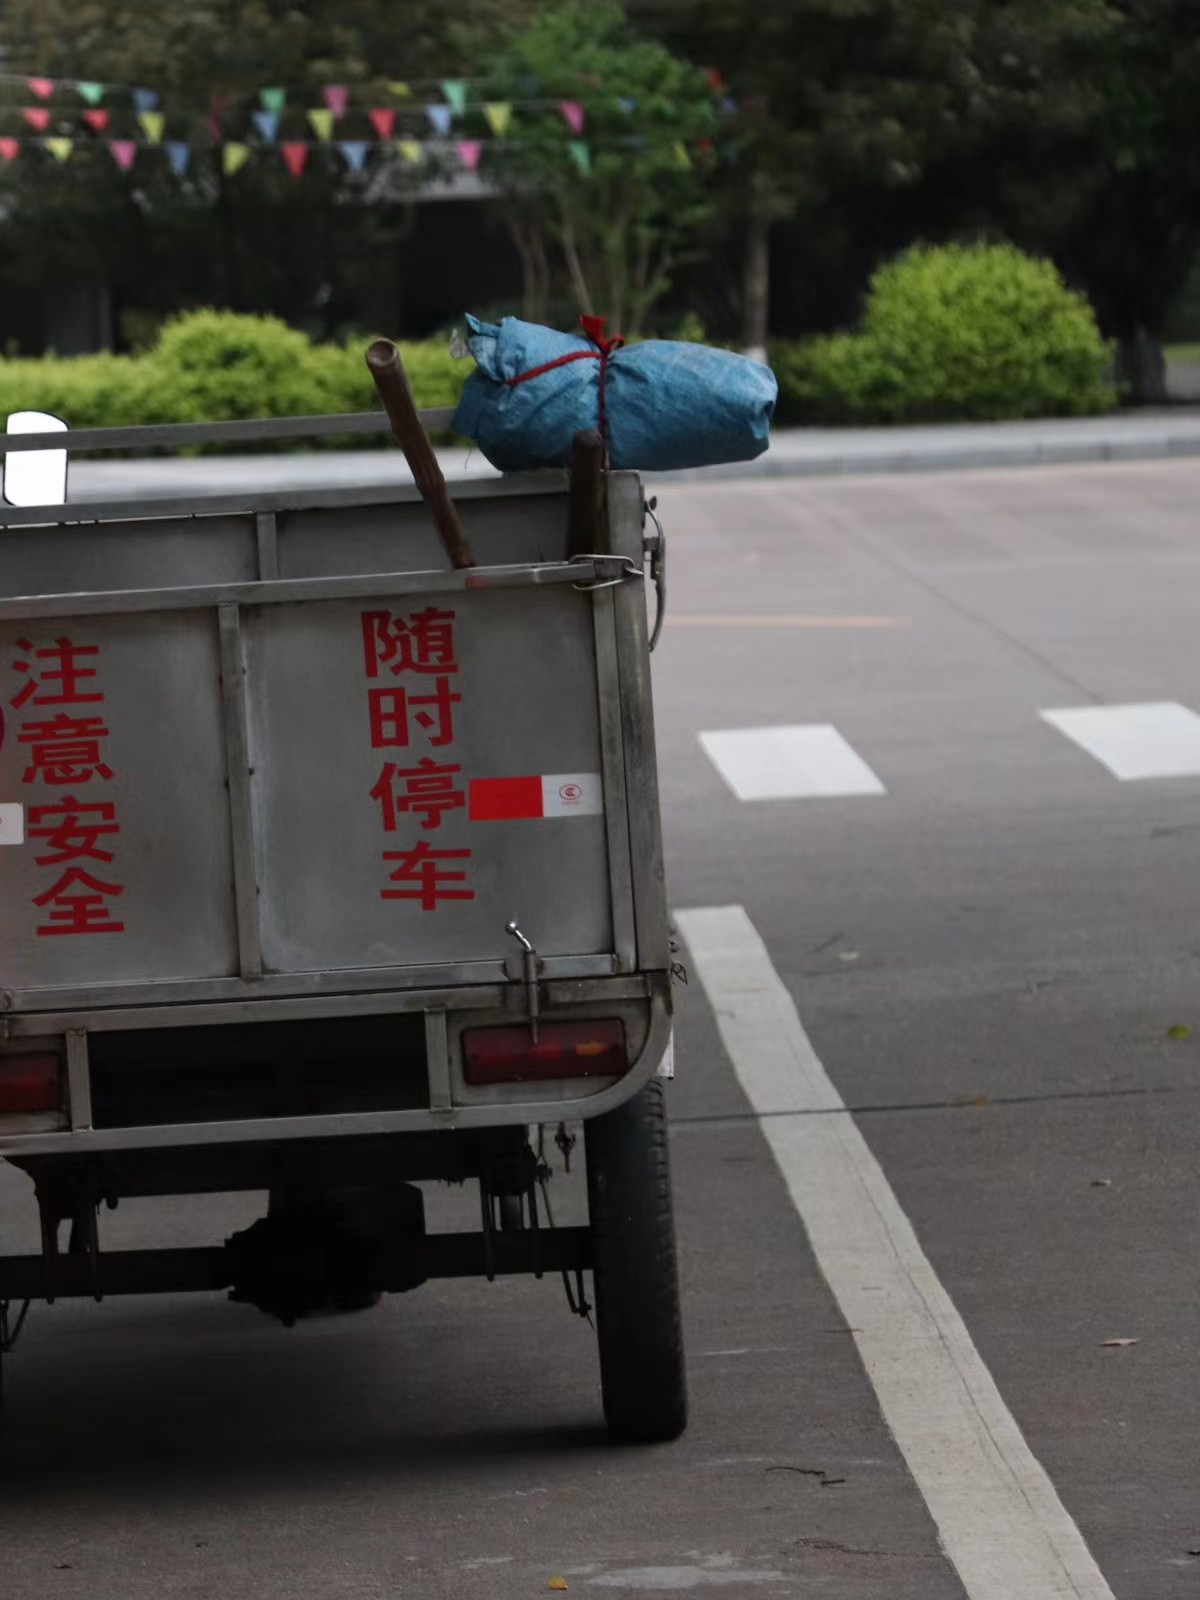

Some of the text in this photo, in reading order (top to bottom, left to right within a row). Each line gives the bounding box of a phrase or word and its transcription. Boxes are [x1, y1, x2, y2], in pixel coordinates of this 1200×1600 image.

[10, 637, 124, 936] 注意安全
[361, 607, 475, 911] 随时停车
